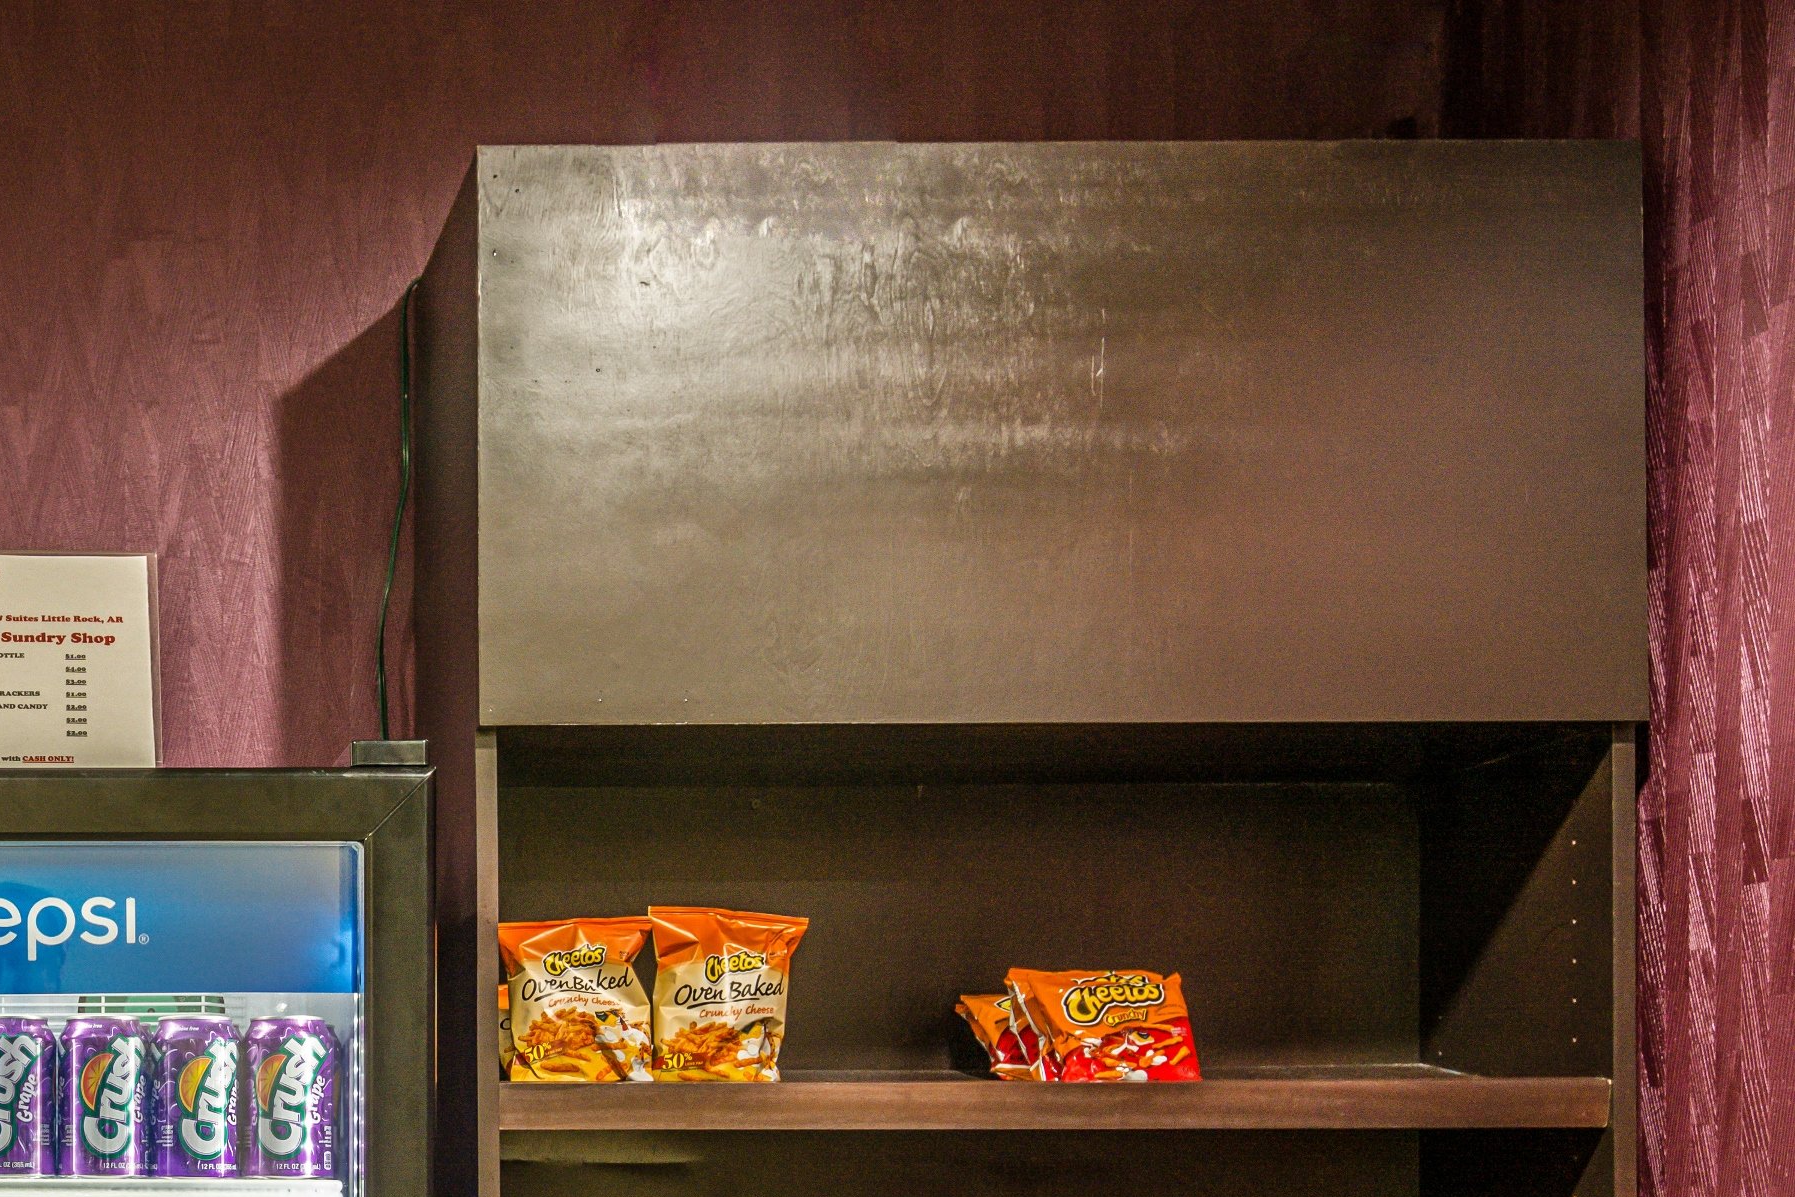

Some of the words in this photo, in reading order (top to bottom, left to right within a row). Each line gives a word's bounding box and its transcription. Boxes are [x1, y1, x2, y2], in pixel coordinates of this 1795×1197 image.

[5, 614, 39, 623] Suites
[41, 614, 71, 623] Little
[106, 615, 124, 624] AR
[0, 631, 67, 646] Sundry
[70, 632, 116, 646] Shop
[22, 755, 47, 764] CASH
[47, 755, 75, 764] ONLY!
[544, 947, 605, 976] Cheetos
[705, 952, 764, 983] Cheetos
[522, 978, 573, 1001] Oven
[674, 984, 726, 1006] Oven
[730, 974, 784, 999] Baked
[746, 1004, 774, 1014] Cheese
[1064, 983, 1162, 1023] Cheetos
[1104, 1009, 1147, 1026] Crunchy
[662, 1053, 692, 1069] 50%
[16, 1073, 39, 1123] Grape
[83, 1037, 146, 1154] Crush
[259, 1035, 327, 1156] Crush
